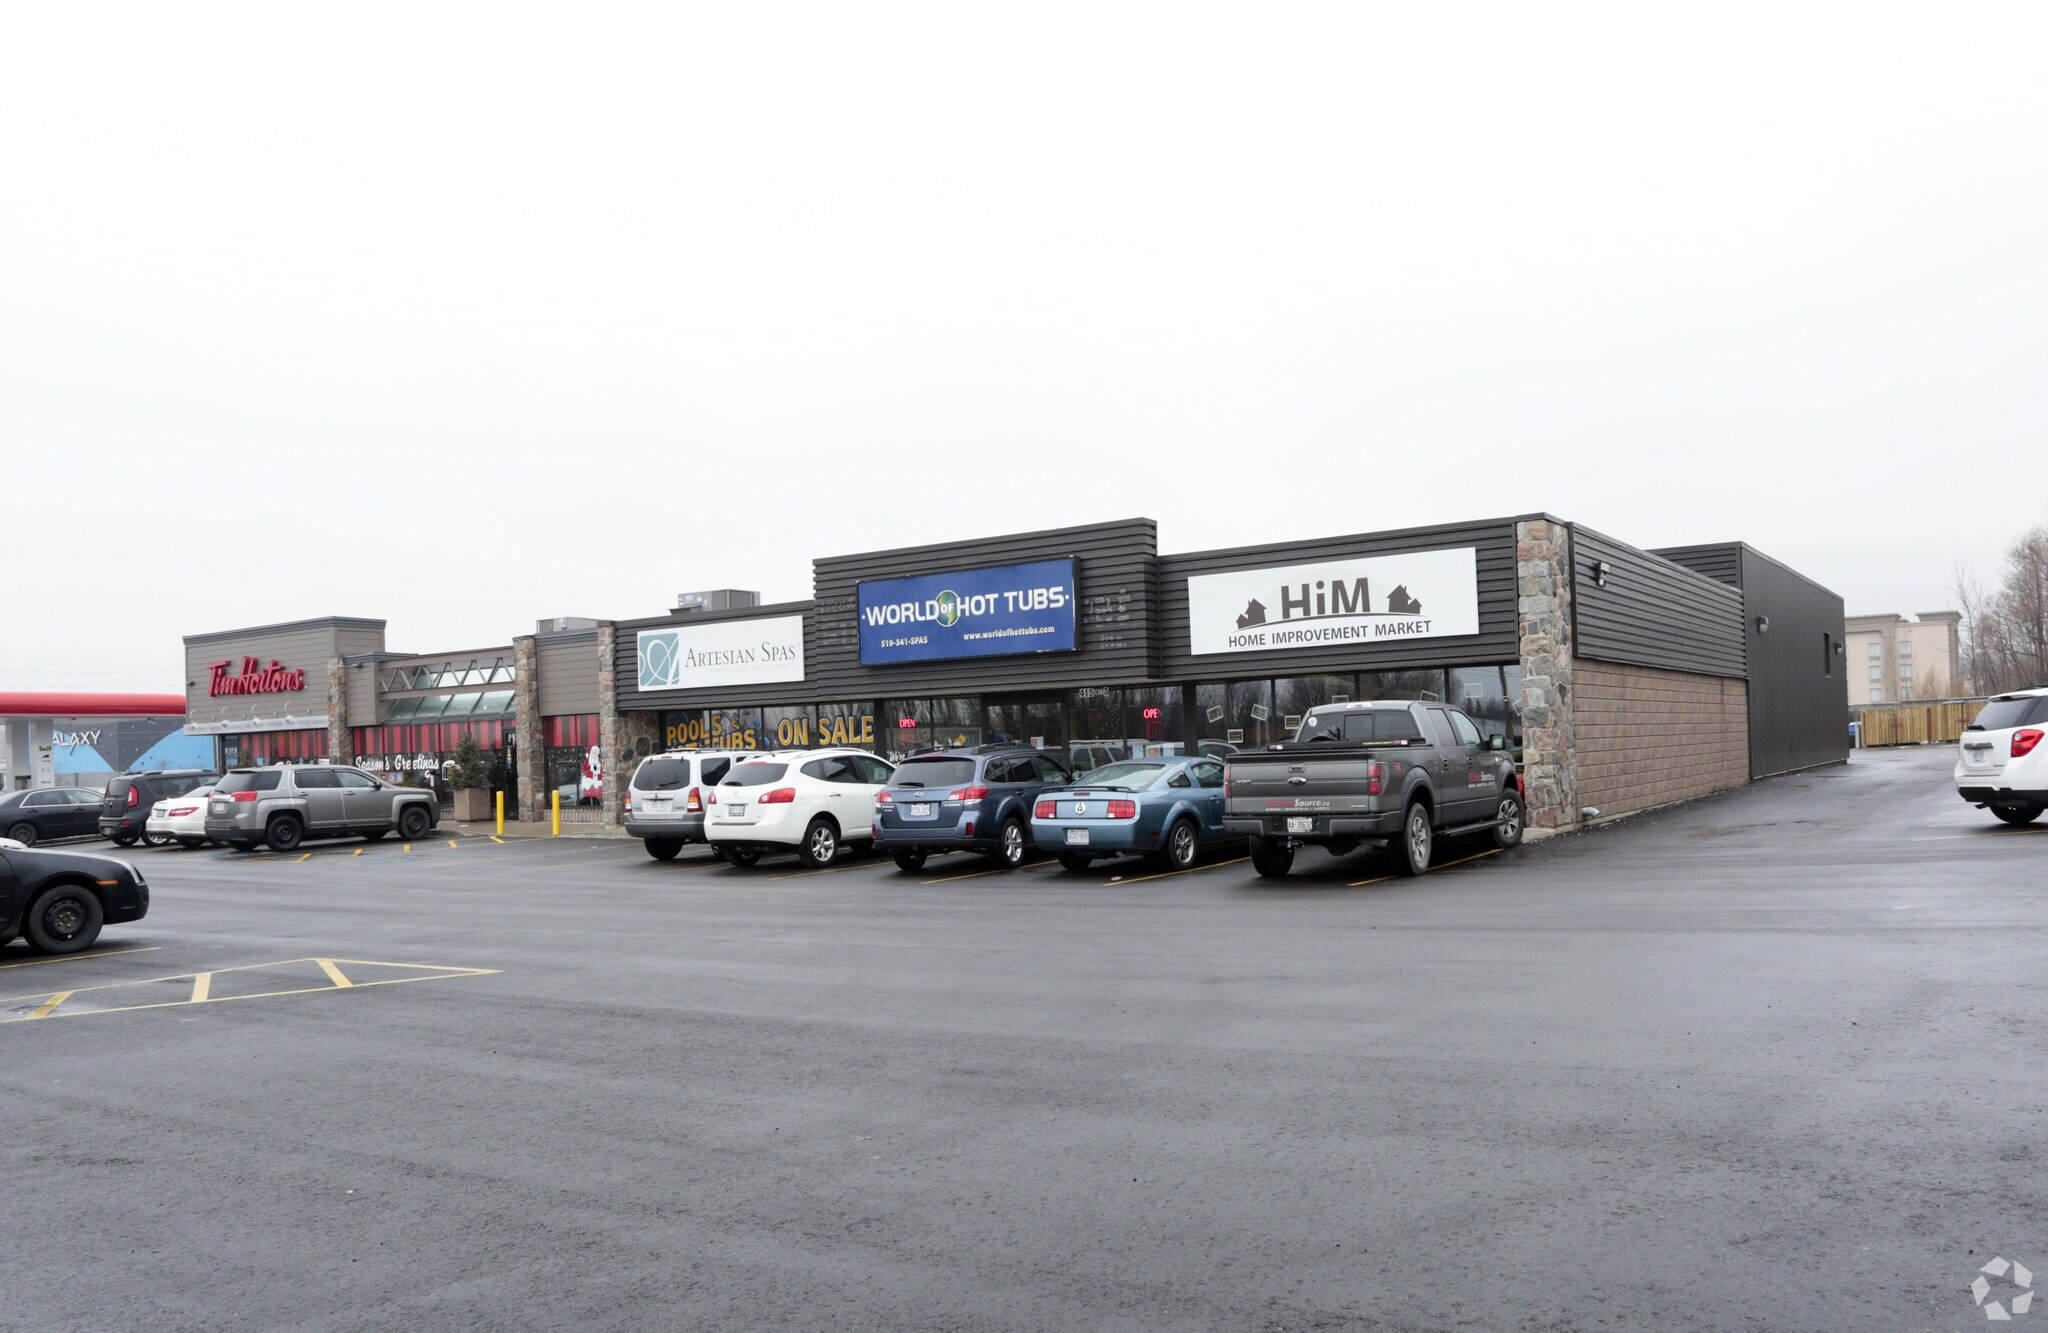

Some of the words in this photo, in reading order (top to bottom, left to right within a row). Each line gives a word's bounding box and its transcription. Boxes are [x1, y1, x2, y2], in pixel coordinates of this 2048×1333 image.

[865, 600, 940, 627] WORLD
[940, 603, 955, 614] OF
[956, 593, 999, 617] HOT
[1003, 586, 1064, 613] TUBS
[1280, 576, 1371, 620] HiM
[880, 635, 929, 648] 519-341-SPAS
[963, 625, 1056, 641] www.worldofhottubs.com
[1228, 633, 1266, 648] HOME
[1271, 625, 1369, 645] IMPROVEMENT
[1374, 620, 1432, 637] MARKET
[207, 660, 239, 698] Tim
[237, 655, 305, 695] Hortons
[666, 713, 724, 747] POOLS
[778, 718, 809, 746] ON
[819, 715, 875, 746] SALE
[899, 718, 917, 728] OPEN
[53, 730, 102, 756] ALAXY
[355, 755, 390, 771] Season's
